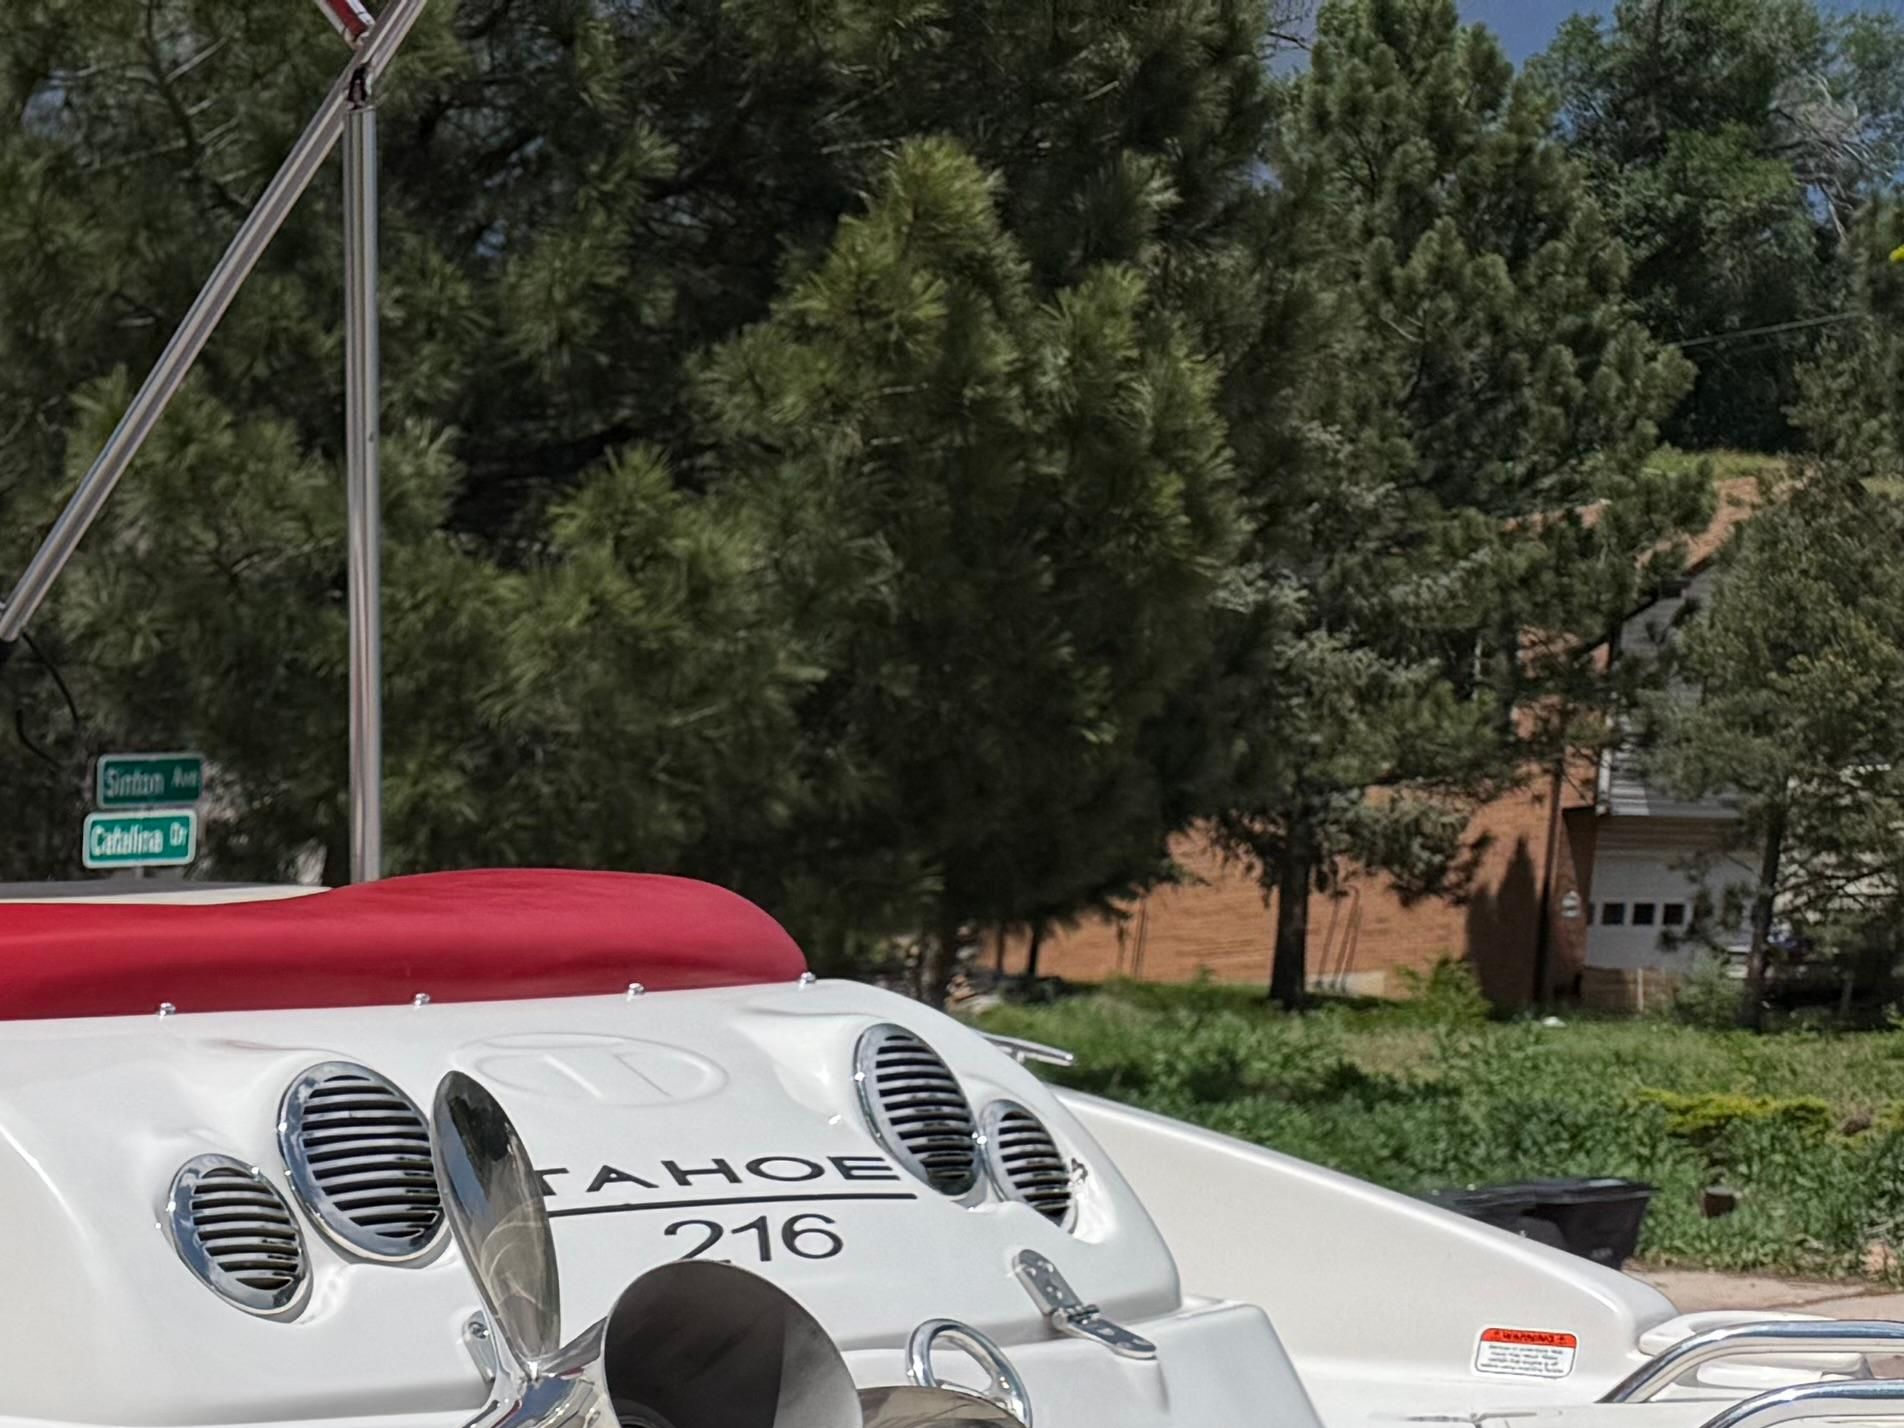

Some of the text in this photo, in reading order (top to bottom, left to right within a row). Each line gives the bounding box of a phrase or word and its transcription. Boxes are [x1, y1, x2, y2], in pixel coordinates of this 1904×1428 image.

[104, 766, 165, 799] Sinton
[90, 821, 189, 857] Catalina Dr
[533, 1155, 902, 1197] TAHOE
[663, 1213, 844, 1264] 216
